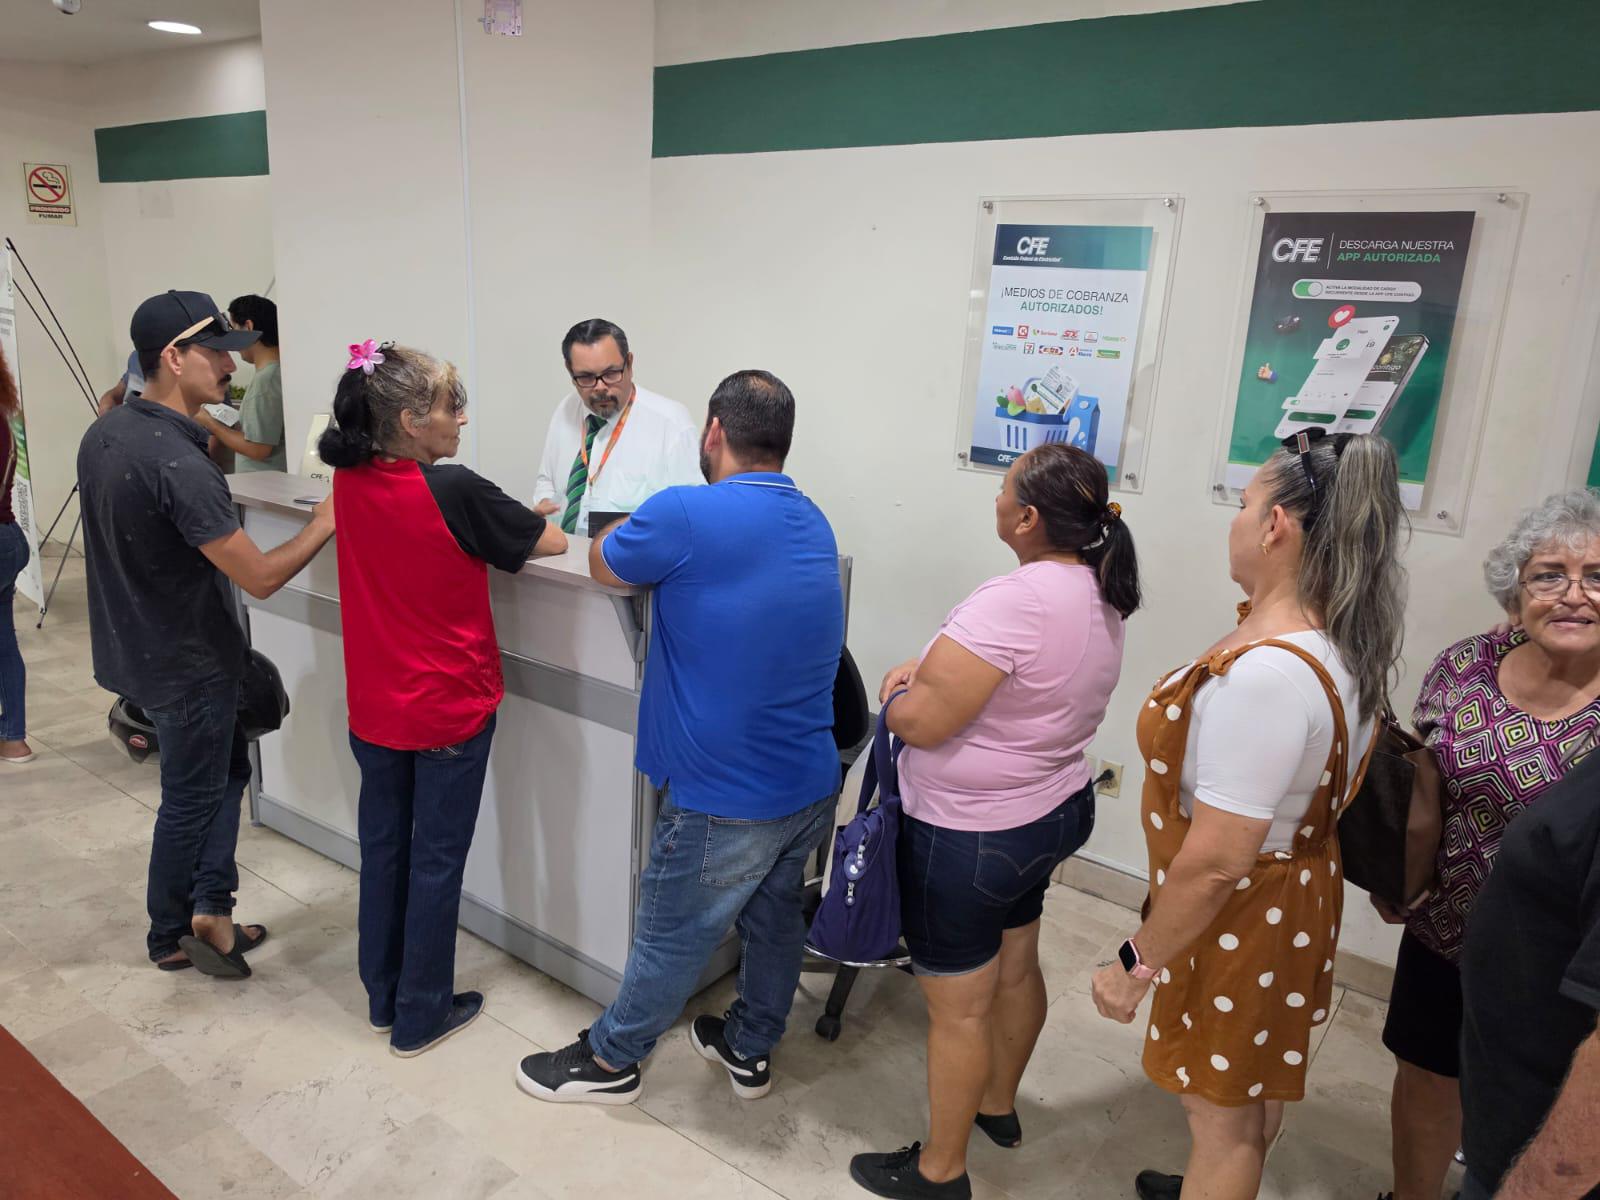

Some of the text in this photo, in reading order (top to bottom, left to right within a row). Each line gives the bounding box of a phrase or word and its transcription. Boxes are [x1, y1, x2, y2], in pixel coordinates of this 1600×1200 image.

[1017, 236, 1050, 255] CFE
[1271, 237, 1325, 263] CFE
[1339, 240, 1455, 250] DESCARGA NUESTRA
[1337, 252, 1441, 263] APP AUTORIZADA
[1001, 287, 1129, 303] ¡MEDIOS DE COBRANZA
[1020, 301, 1104, 316] AUTORIZADOS!
